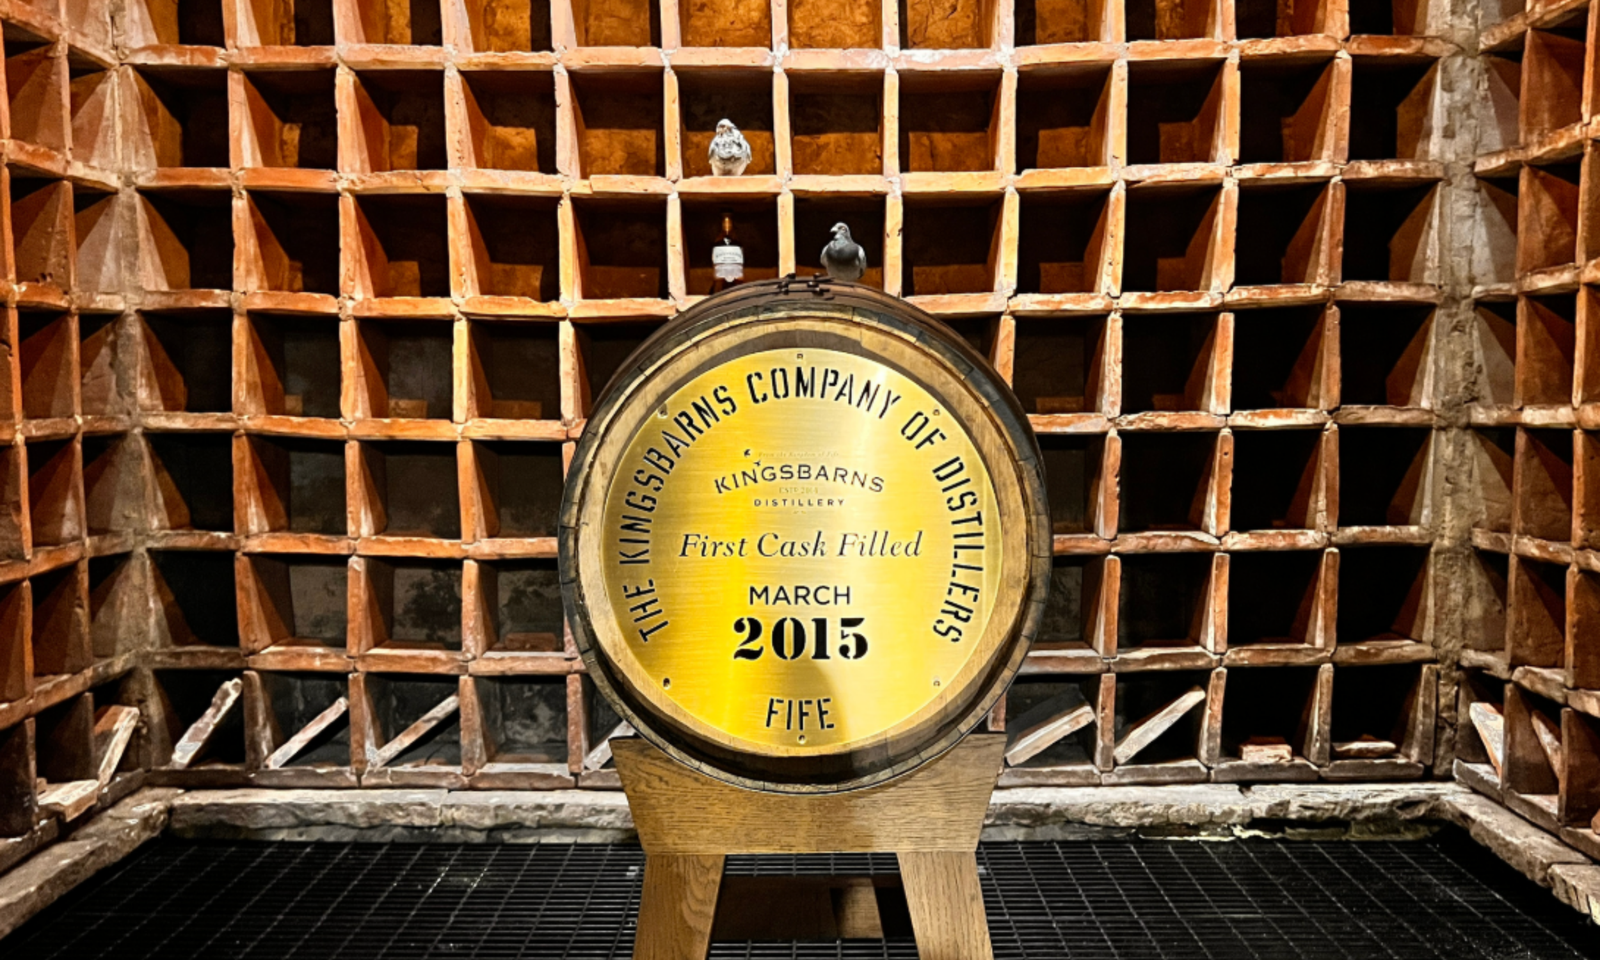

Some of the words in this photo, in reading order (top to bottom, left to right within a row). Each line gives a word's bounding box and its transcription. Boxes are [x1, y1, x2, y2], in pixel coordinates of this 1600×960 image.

[746, 366, 902, 419] COMPANY
[900, 411, 947, 450] OF
[619, 385, 737, 565] KINGSBARNS
[714, 464, 885, 494] KINGSBARNS
[754, 499, 845, 507] DISTILLERY
[679, 533, 749, 557] First
[757, 530, 828, 557] Cask
[836, 530, 923, 557] Filled
[932, 455, 985, 643] DISTILLERS
[625, 579, 669, 642] THE
[749, 585, 851, 605] MARCH
[733, 616, 869, 661] 2015
[766, 698, 835, 730] FIFE
